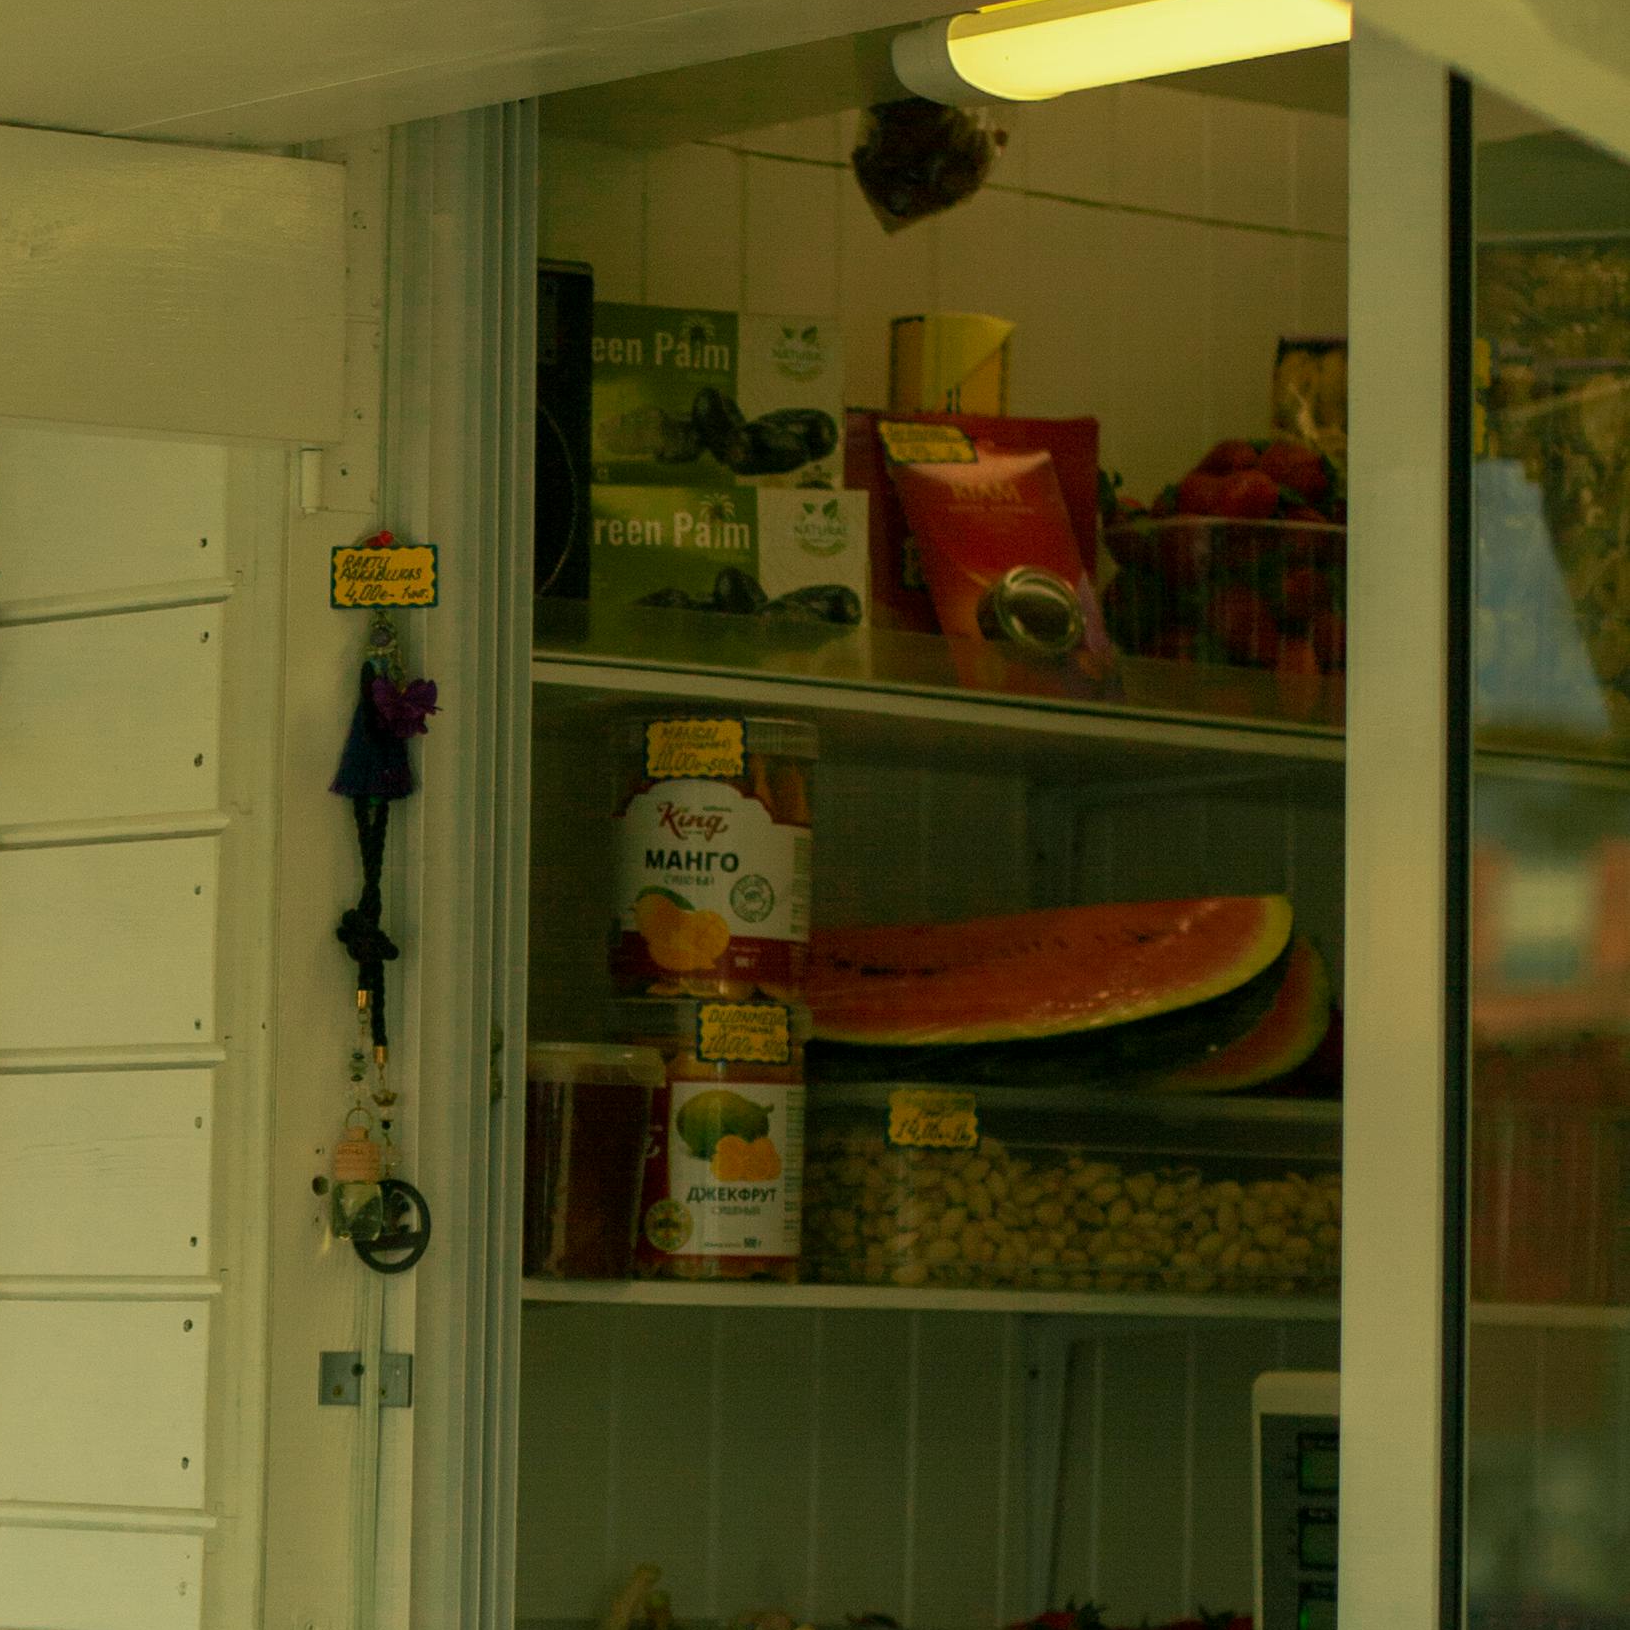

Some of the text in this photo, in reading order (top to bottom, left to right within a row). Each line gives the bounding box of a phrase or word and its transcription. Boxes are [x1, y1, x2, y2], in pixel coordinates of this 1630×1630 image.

[591, 331, 730, 371] een Palm
[593, 510, 751, 550] reen Palm
[656, 800, 730, 843] King
[645, 849, 740, 873] МАНГО
[685, 1186, 777, 1204] ДЖЕКФРУТ
